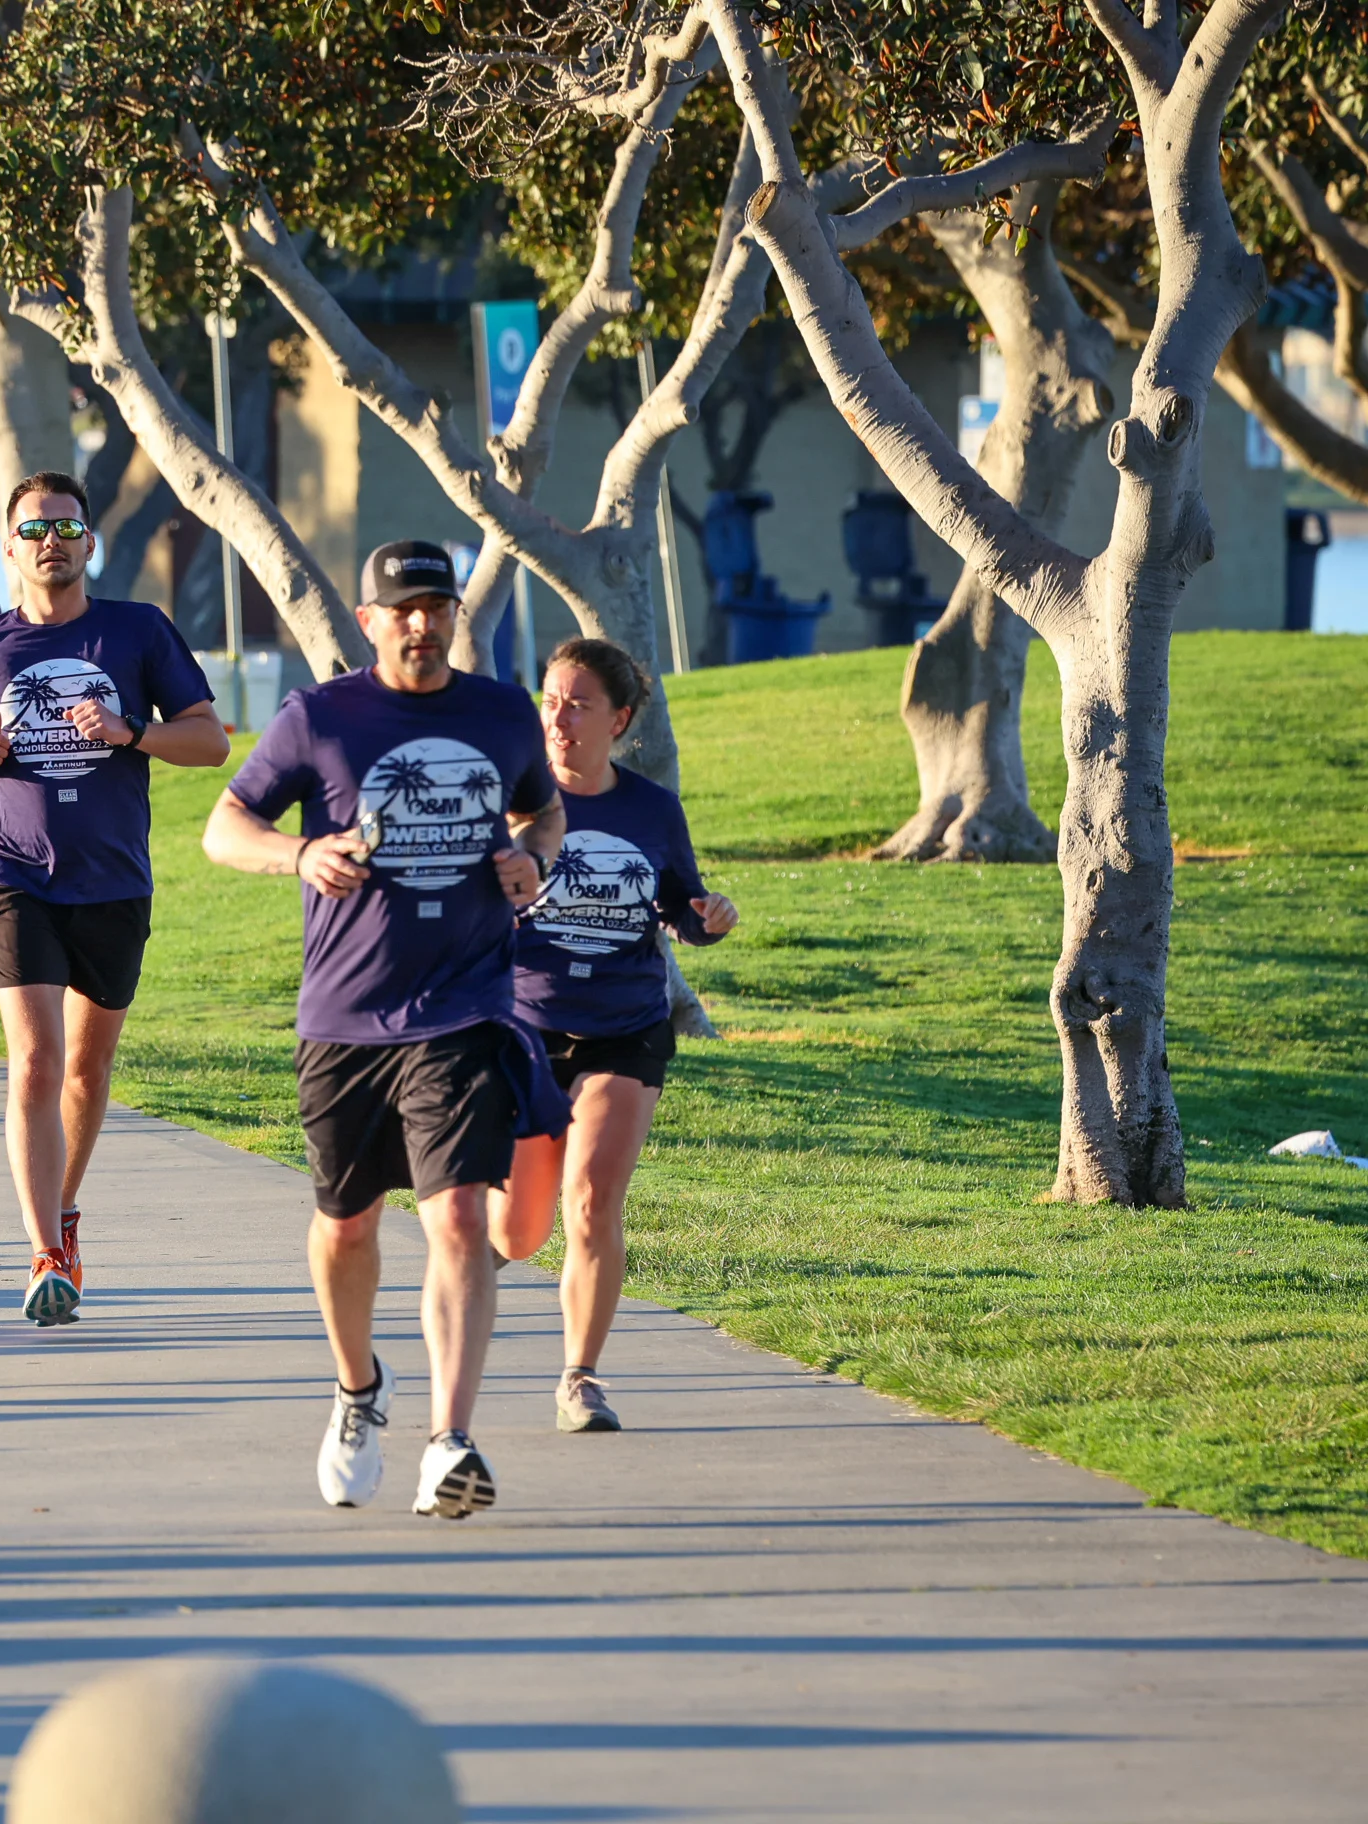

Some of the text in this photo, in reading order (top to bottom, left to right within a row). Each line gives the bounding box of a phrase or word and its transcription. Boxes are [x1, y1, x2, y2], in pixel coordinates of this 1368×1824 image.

[39, 705, 75, 722] O&
[8, 728, 86, 745] POWERU
[64, 743, 77, 752] CA
[384, 822, 494, 843] OWERUP 5K
[628, 907, 650, 923] 5K
